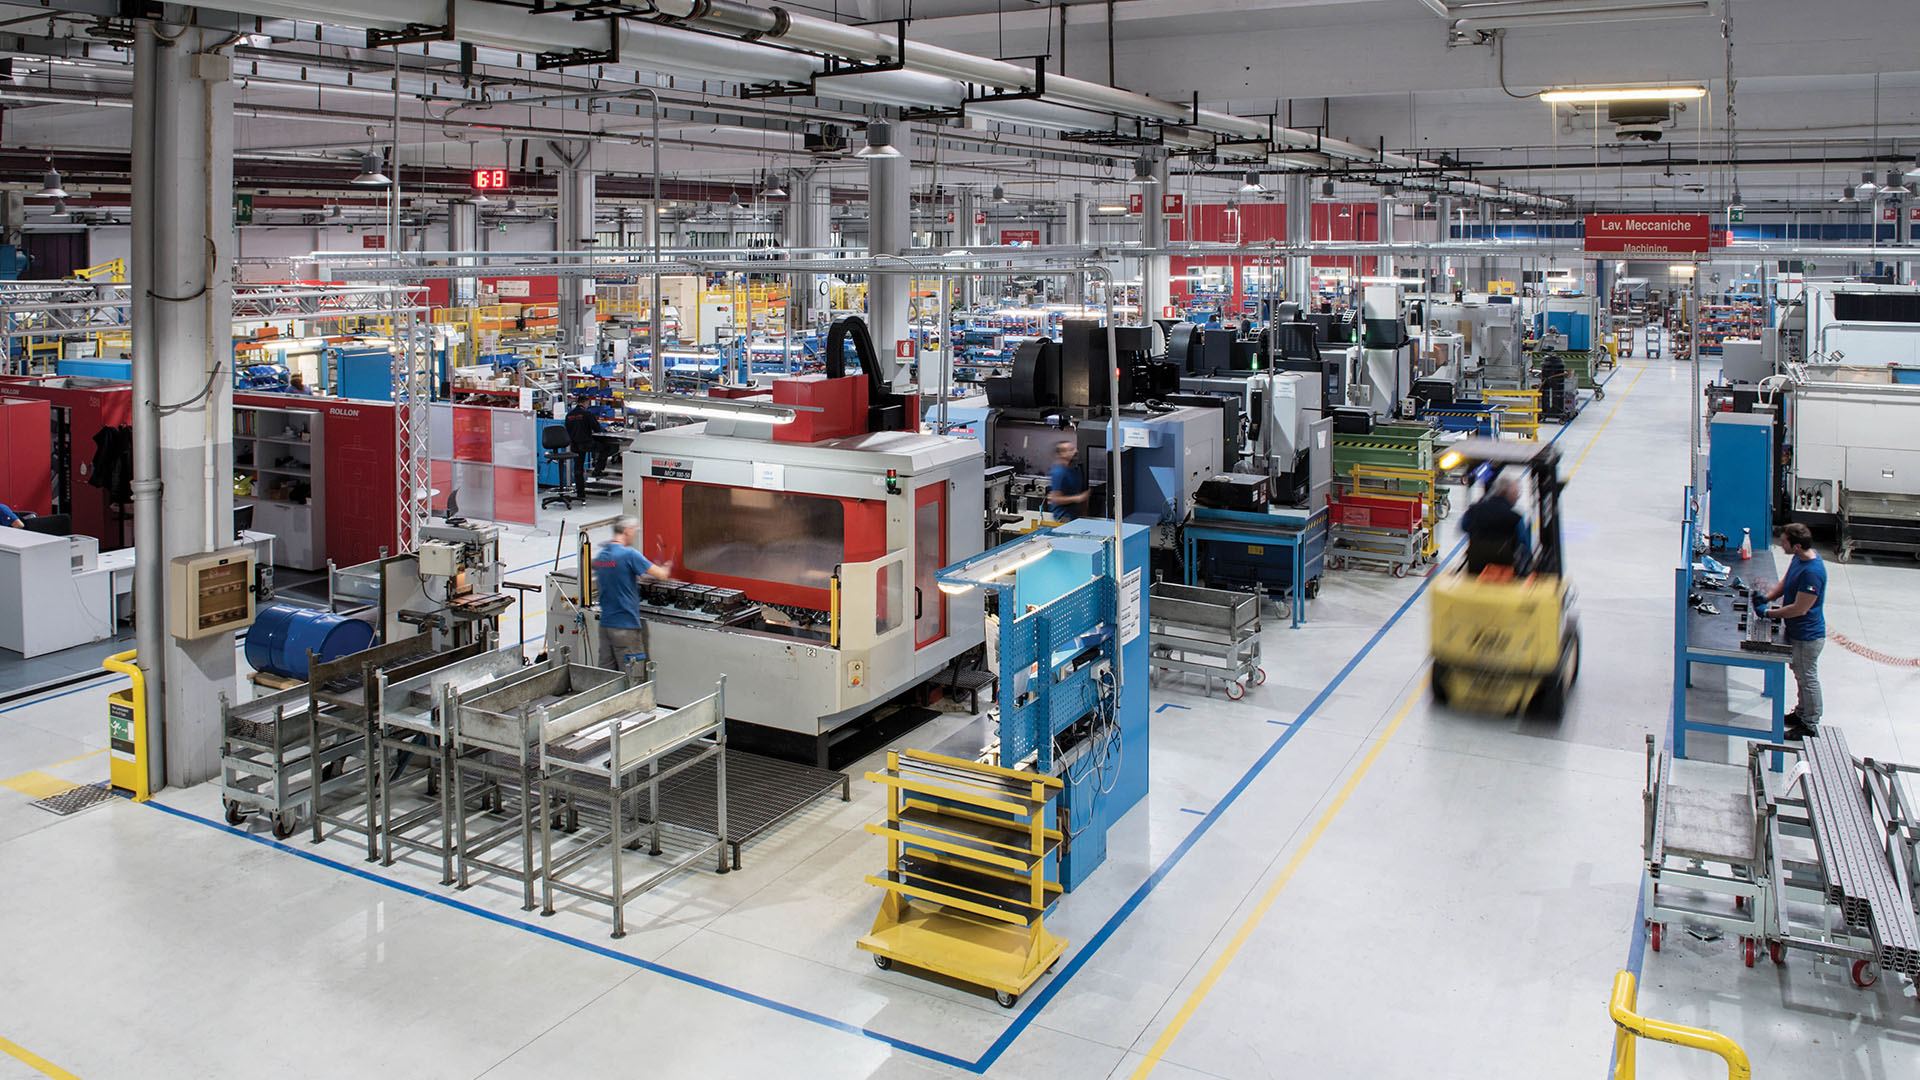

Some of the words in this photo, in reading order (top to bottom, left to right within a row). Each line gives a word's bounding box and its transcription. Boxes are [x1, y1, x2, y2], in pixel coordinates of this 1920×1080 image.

[477, 171, 504, 188] 16:13
[1601, 220, 1623, 231] Lav.
[1625, 219, 1691, 231] Meccaniche
[1623, 243, 1668, 253] Machining
[329, 407, 359, 417] ROLLON
